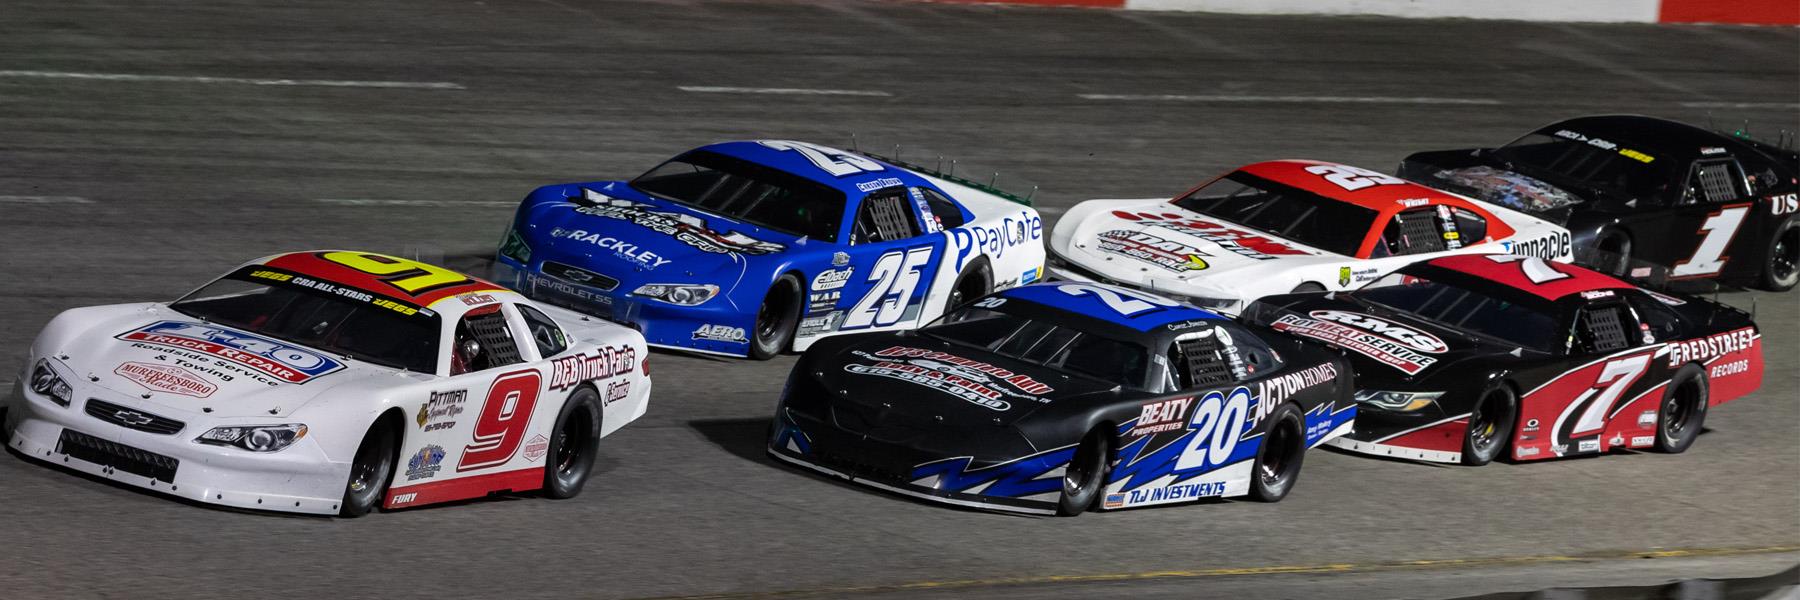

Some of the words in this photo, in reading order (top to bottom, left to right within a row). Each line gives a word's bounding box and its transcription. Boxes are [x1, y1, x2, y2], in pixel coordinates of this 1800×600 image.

[568, 229, 672, 267] RACKLEY
[1667, 203, 1752, 279] 1
[291, 277, 314, 291] CRA
[314, 281, 373, 302] ALL-STARS
[372, 297, 418, 316] JEGS
[527, 273, 594, 300] CHEVROLET
[595, 294, 612, 305] SS
[841, 245, 934, 329] 25
[1281, 315, 1316, 328] ROY
[1315, 321, 1362, 340] MEAT
[1358, 333, 1432, 366] SERVICE
[1322, 311, 1444, 352] RMS
[131, 342, 209, 363] Roadside
[214, 360, 279, 386] Service
[144, 333, 211, 352] TRUCK
[218, 346, 295, 380] REPAIR
[175, 360, 235, 382] Towing
[578, 348, 611, 380] Truck
[1711, 359, 1749, 378] RECORDS
[121, 363, 212, 395] MURFREESBORO
[1570, 353, 1652, 435] 7
[428, 389, 468, 409] PITTMAN
[1137, 397, 1193, 428] BEATY
[1252, 373, 1307, 429] ACTION
[456, 368, 543, 473] 9
[1131, 421, 1184, 437] PROPERTIES
[1174, 386, 1251, 471] 20
[391, 492, 418, 505] FURY
[1151, 481, 1226, 502] INVESTMENTS
